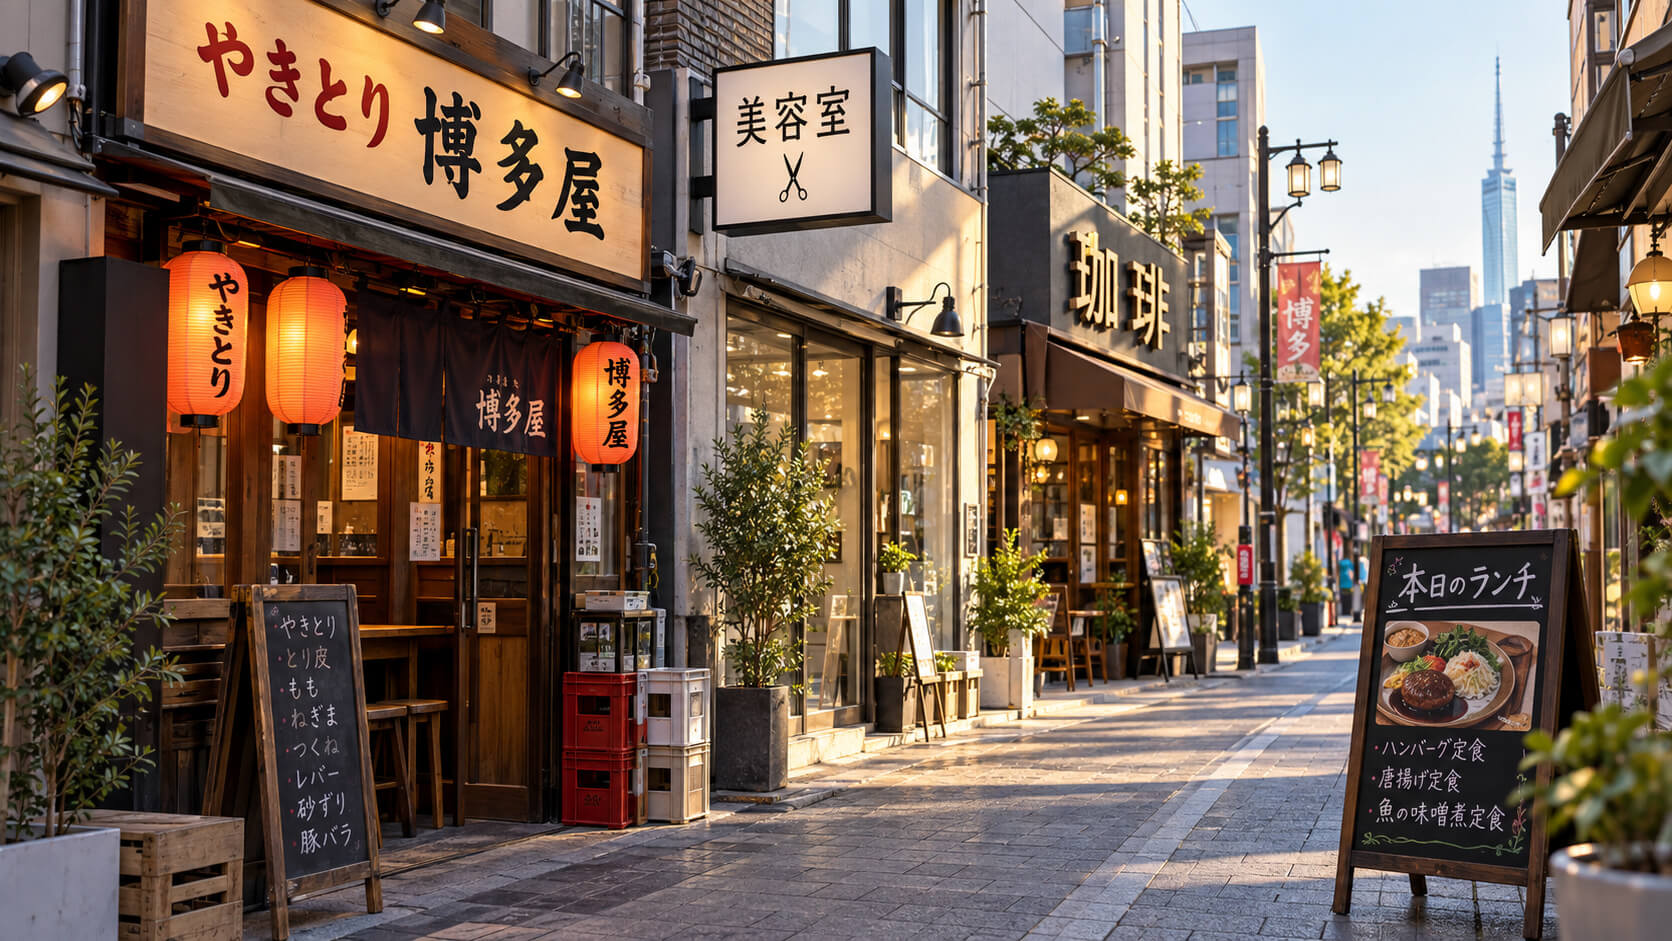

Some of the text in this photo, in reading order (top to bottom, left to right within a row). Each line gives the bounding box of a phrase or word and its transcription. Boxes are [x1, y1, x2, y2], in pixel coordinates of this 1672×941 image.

[197, 21, 606, 241] やきとり 博多屋
[736, 85, 850, 148] 美容室
[1069, 231, 1171, 350] 珈琲
[208, 272, 241, 398] やきとり
[1282, 296, 1315, 362] 博多
[476, 388, 547, 438] 博多屋
[603, 357, 631, 449] 博多屋
[1398, 562, 1537, 604] 本日のランチ
[280, 615, 336, 640] やきとり
[286, 645, 331, 670] とり皮
[289, 676, 318, 700] もも
[291, 704, 338, 729] ねぎま
[293, 735, 340, 758] つくね
[1382, 737, 1487, 763] ハンバーグ定食
[296, 764, 340, 789] レバー
[1378, 765, 1462, 794] 唐揚げ定食
[297, 791, 345, 822] 砂ずり
[1376, 797, 1506, 833] 魚の味噌煮定食
[301, 823, 352, 855] 豚バラ
